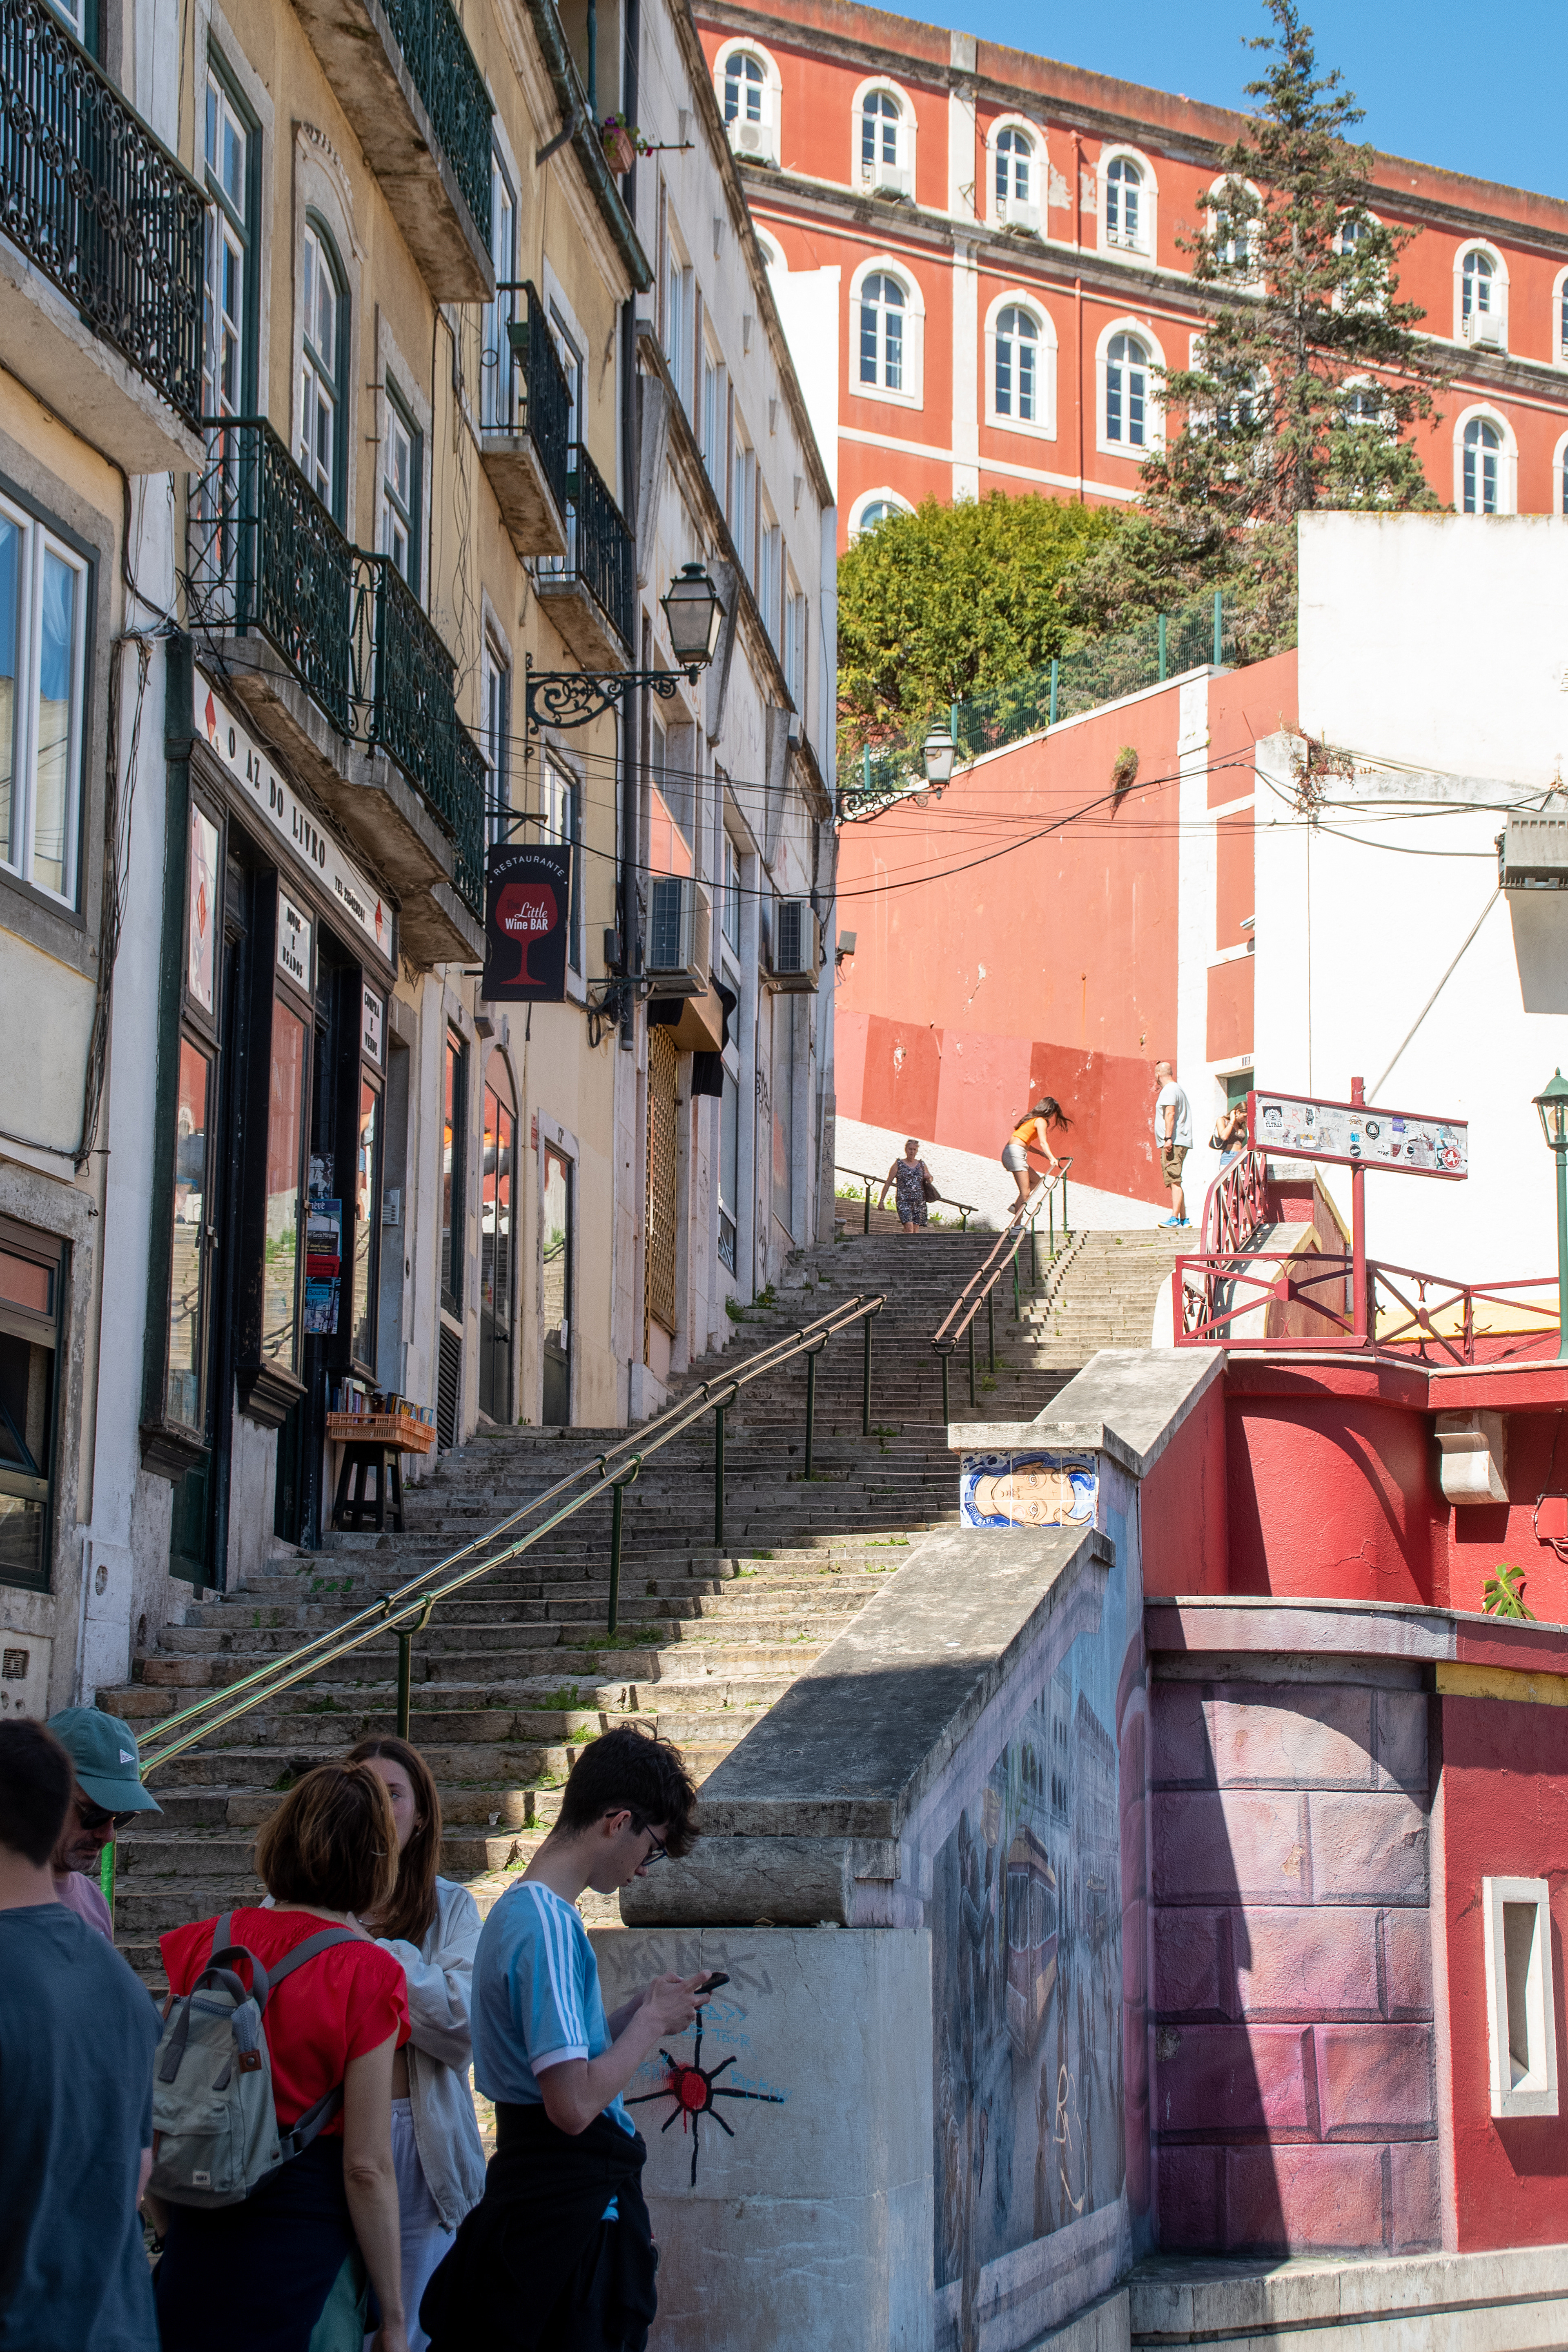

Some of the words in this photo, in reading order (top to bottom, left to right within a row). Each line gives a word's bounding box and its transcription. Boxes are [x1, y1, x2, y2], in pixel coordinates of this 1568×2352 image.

[229, 726, 236, 759] O
[246, 748, 260, 790] AZ
[270, 776, 283, 818] DO
[292, 806, 325, 869] LIVRO
[493, 855, 565, 877] RESTAURANTE
[514, 902, 548, 918] Little
[505, 918, 528, 930] Wine
[530, 918, 548, 930] BAR
[283, 946, 303, 979] USADOS
[1242, 1056, 1250, 1066] 18
[976, 1517, 995, 1525] BLUE
